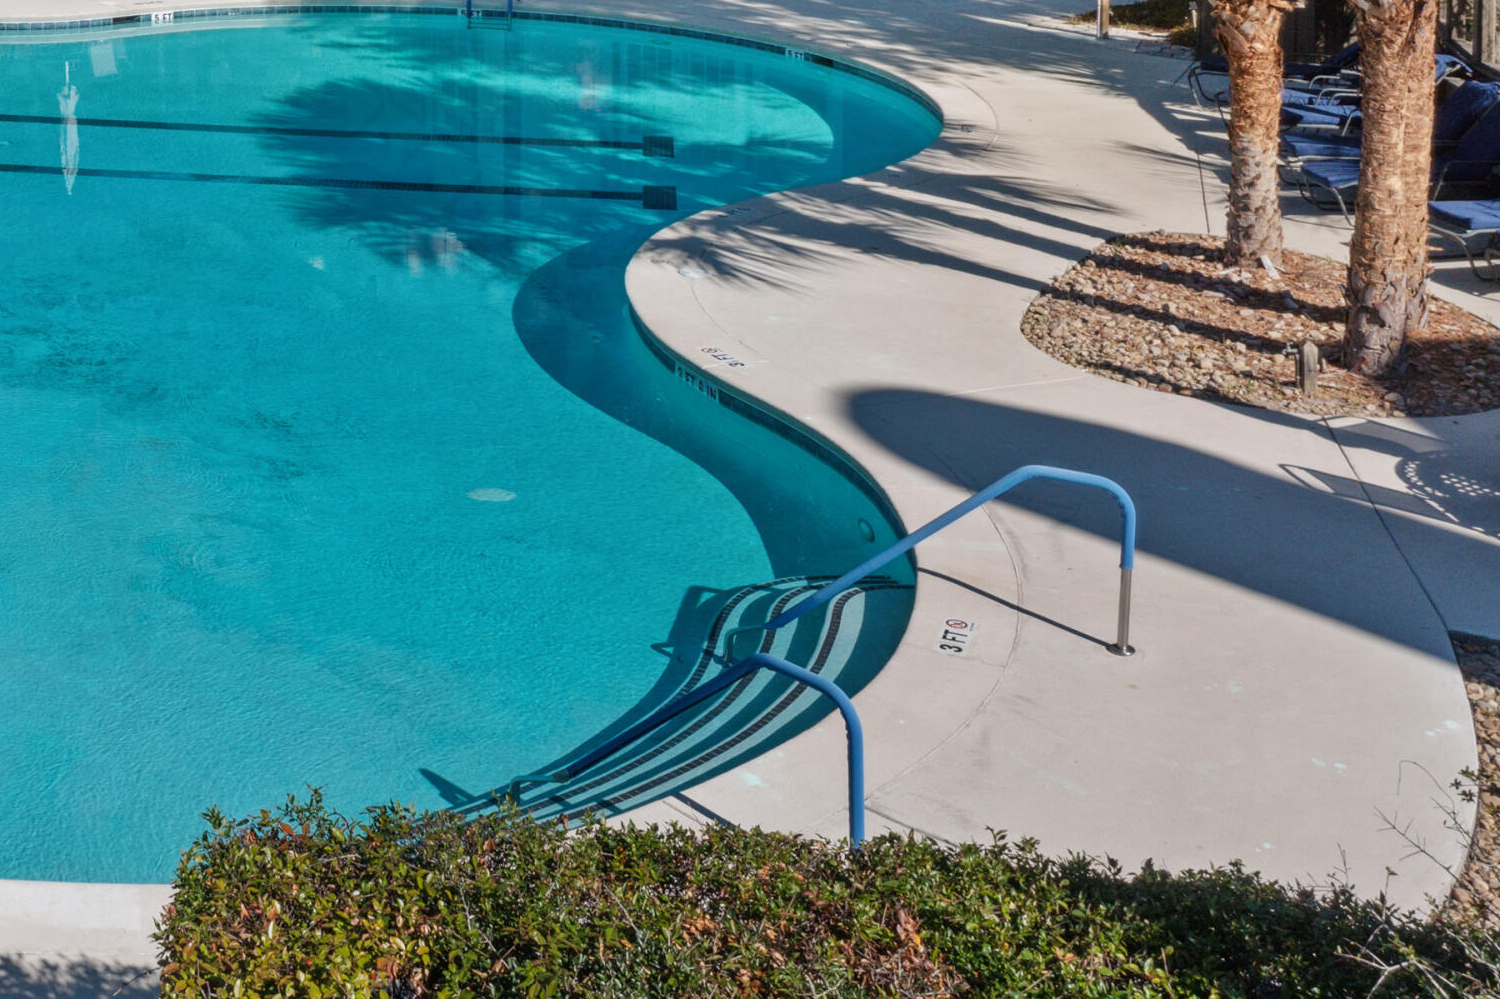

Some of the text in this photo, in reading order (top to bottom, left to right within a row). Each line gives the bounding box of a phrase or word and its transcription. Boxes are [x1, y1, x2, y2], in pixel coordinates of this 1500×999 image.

[684, 371, 696, 386] FT
[706, 384, 717, 400] IN
[939, 629, 968, 653] 3 FT
